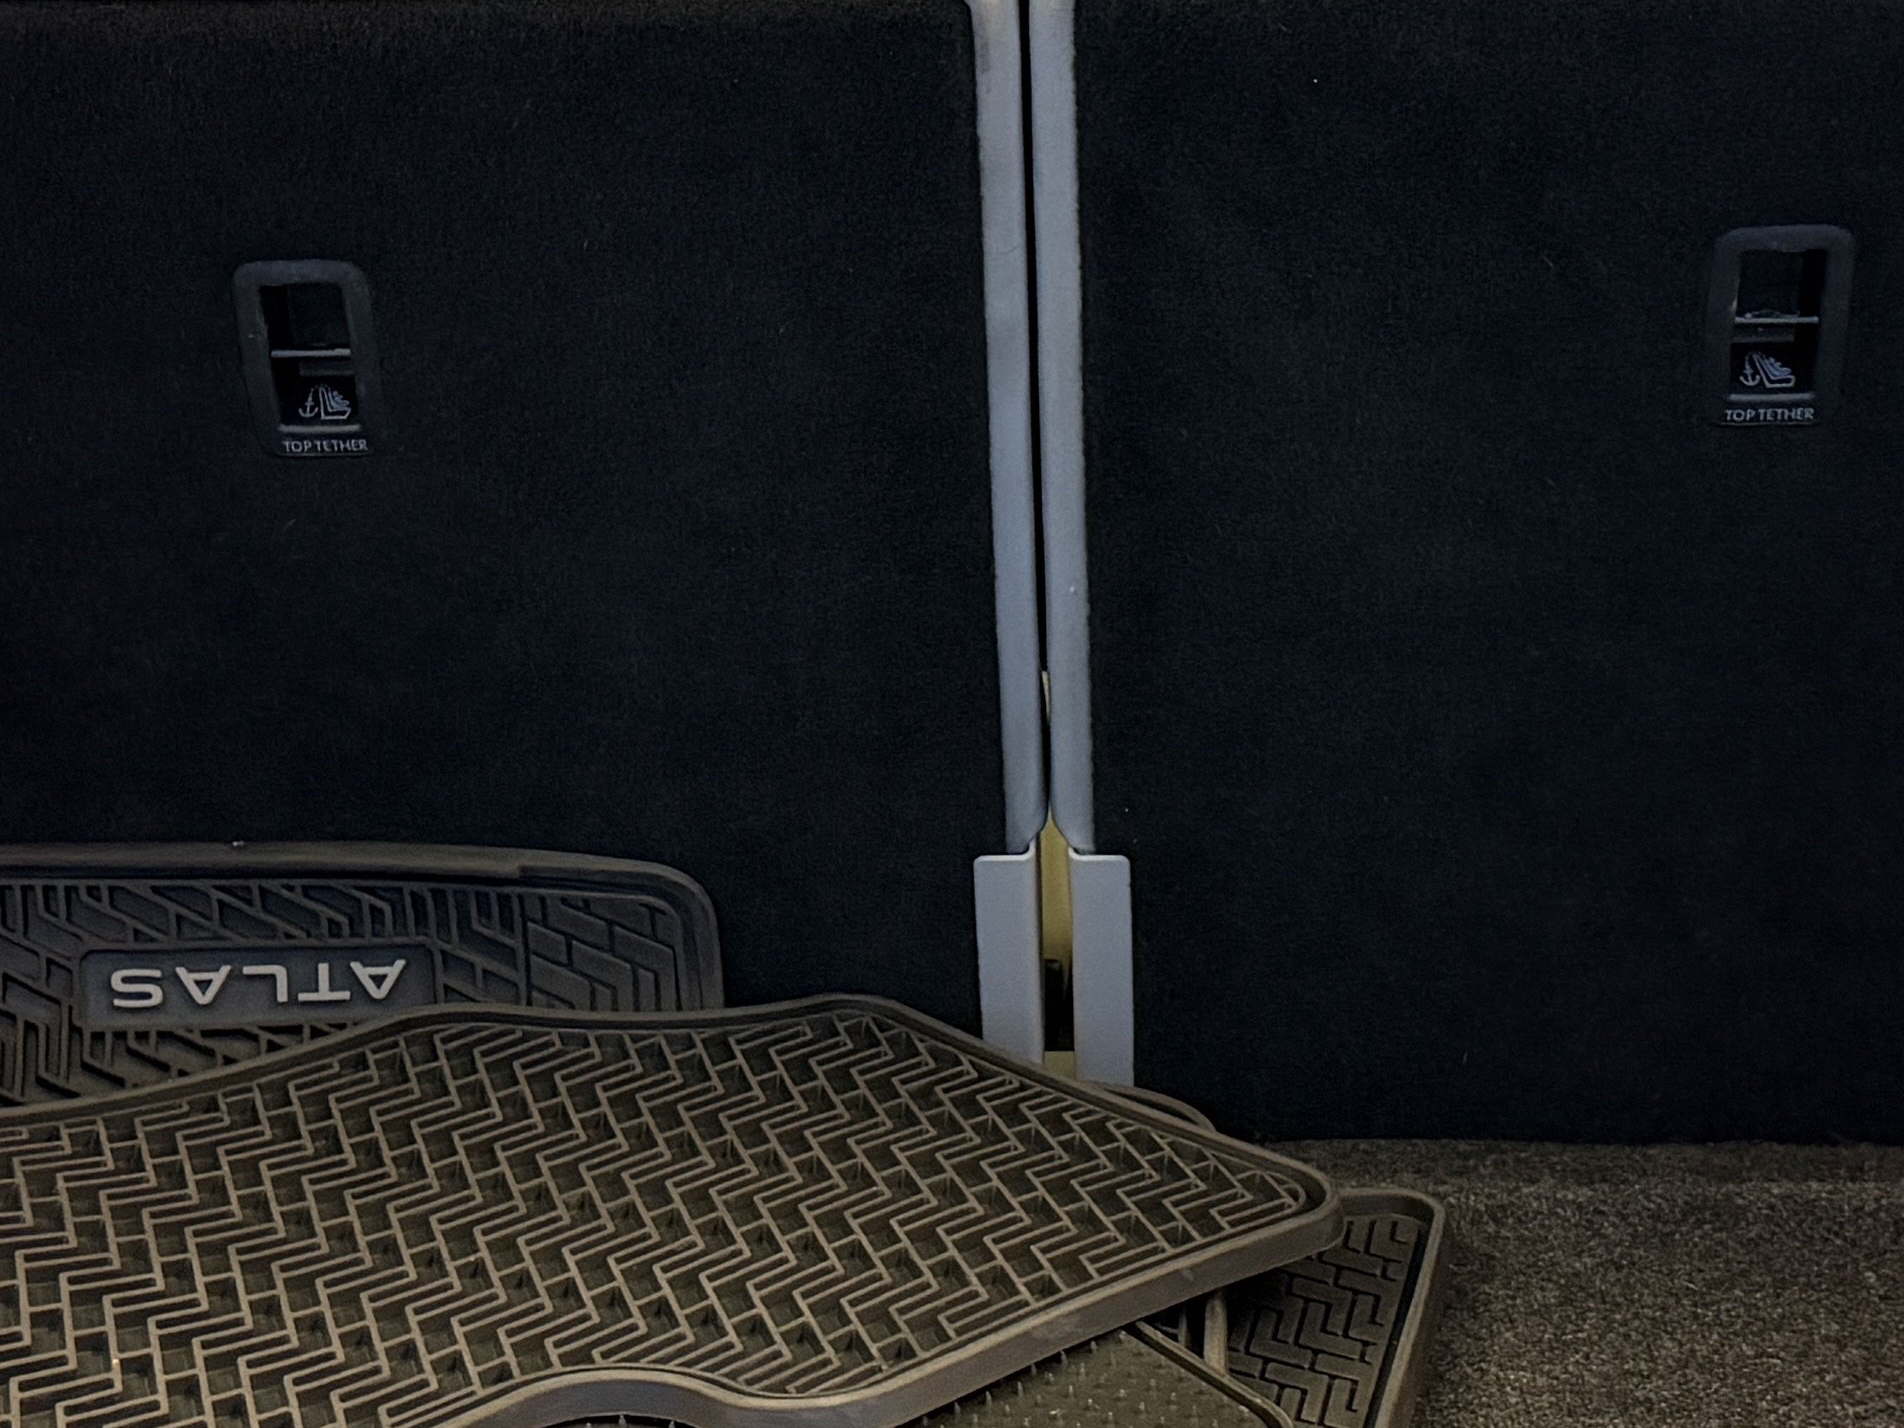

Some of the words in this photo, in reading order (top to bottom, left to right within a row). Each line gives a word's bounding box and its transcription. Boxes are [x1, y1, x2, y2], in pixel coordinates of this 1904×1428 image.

[1724, 408, 1756, 422] TOP
[1757, 407, 1815, 421] TETHER
[281, 439, 312, 453] TOP
[313, 438, 369, 453] TETHER
[110, 958, 407, 1009] ATLAS
